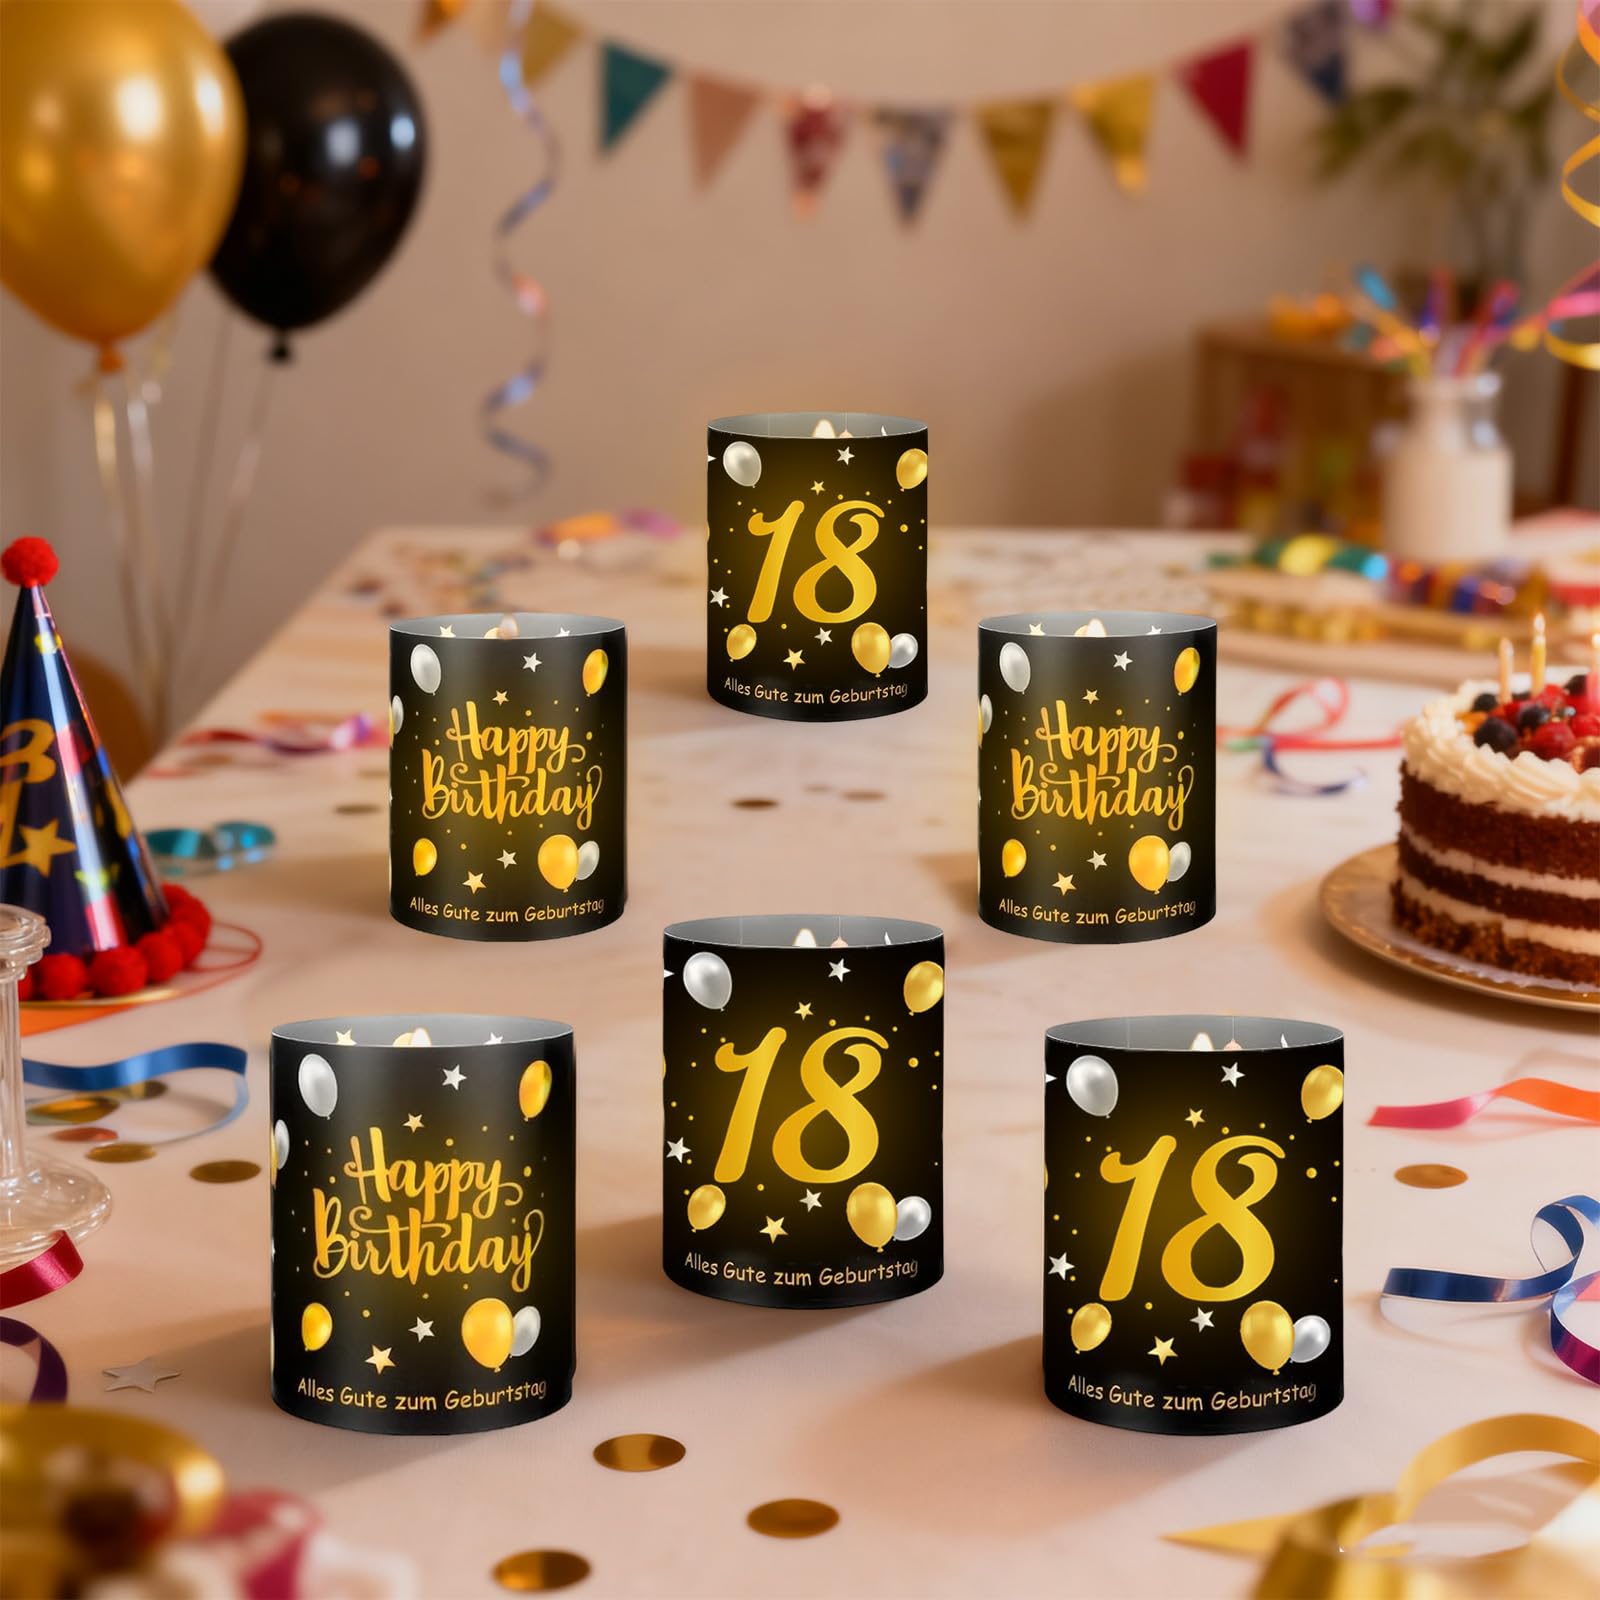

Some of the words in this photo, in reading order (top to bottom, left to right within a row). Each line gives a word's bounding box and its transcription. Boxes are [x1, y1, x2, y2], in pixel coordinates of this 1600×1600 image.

[747, 500, 885, 623] 18
[724, 677, 751, 696] Alles
[754, 684, 789, 704] Gute
[794, 691, 825, 705] zum
[829, 683, 908, 703] Geburtstag
[446, 700, 586, 776] Happy
[1035, 699, 1178, 776] Happy
[422, 748, 603, 830] Birthday
[1011, 748, 1195, 831] Birthday
[410, 897, 439, 916] Alles
[442, 903, 481, 922] Gute
[486, 910, 519, 923] zum
[524, 897, 605, 922] Geburtstag
[998, 898, 1029, 918] Alles
[1032, 905, 1070, 924] Gute
[1076, 912, 1110, 925] zum
[1115, 899, 1196, 924] Geburtstag
[713, 1026, 889, 1184] 18
[344, 1126, 524, 1221] Happy
[313, 1187, 545, 1293] Birthday
[1099, 1134, 1286, 1302] 18
[684, 1251, 719, 1277] Alles
[723, 1261, 767, 1285] Gute
[773, 1269, 812, 1286] zum
[818, 1258, 919, 1286] Geburtstag
[297, 1377, 335, 1402] Alles
[340, 1386, 388, 1410] Gute
[395, 1393, 437, 1411] zum
[444, 1380, 548, 1410] Geburtstag
[1068, 1374, 1104, 1400] Alles
[1108, 1384, 1155, 1410] Gute
[1162, 1392, 1203, 1411] zum
[1211, 1381, 1317, 1410] Geburtstag
